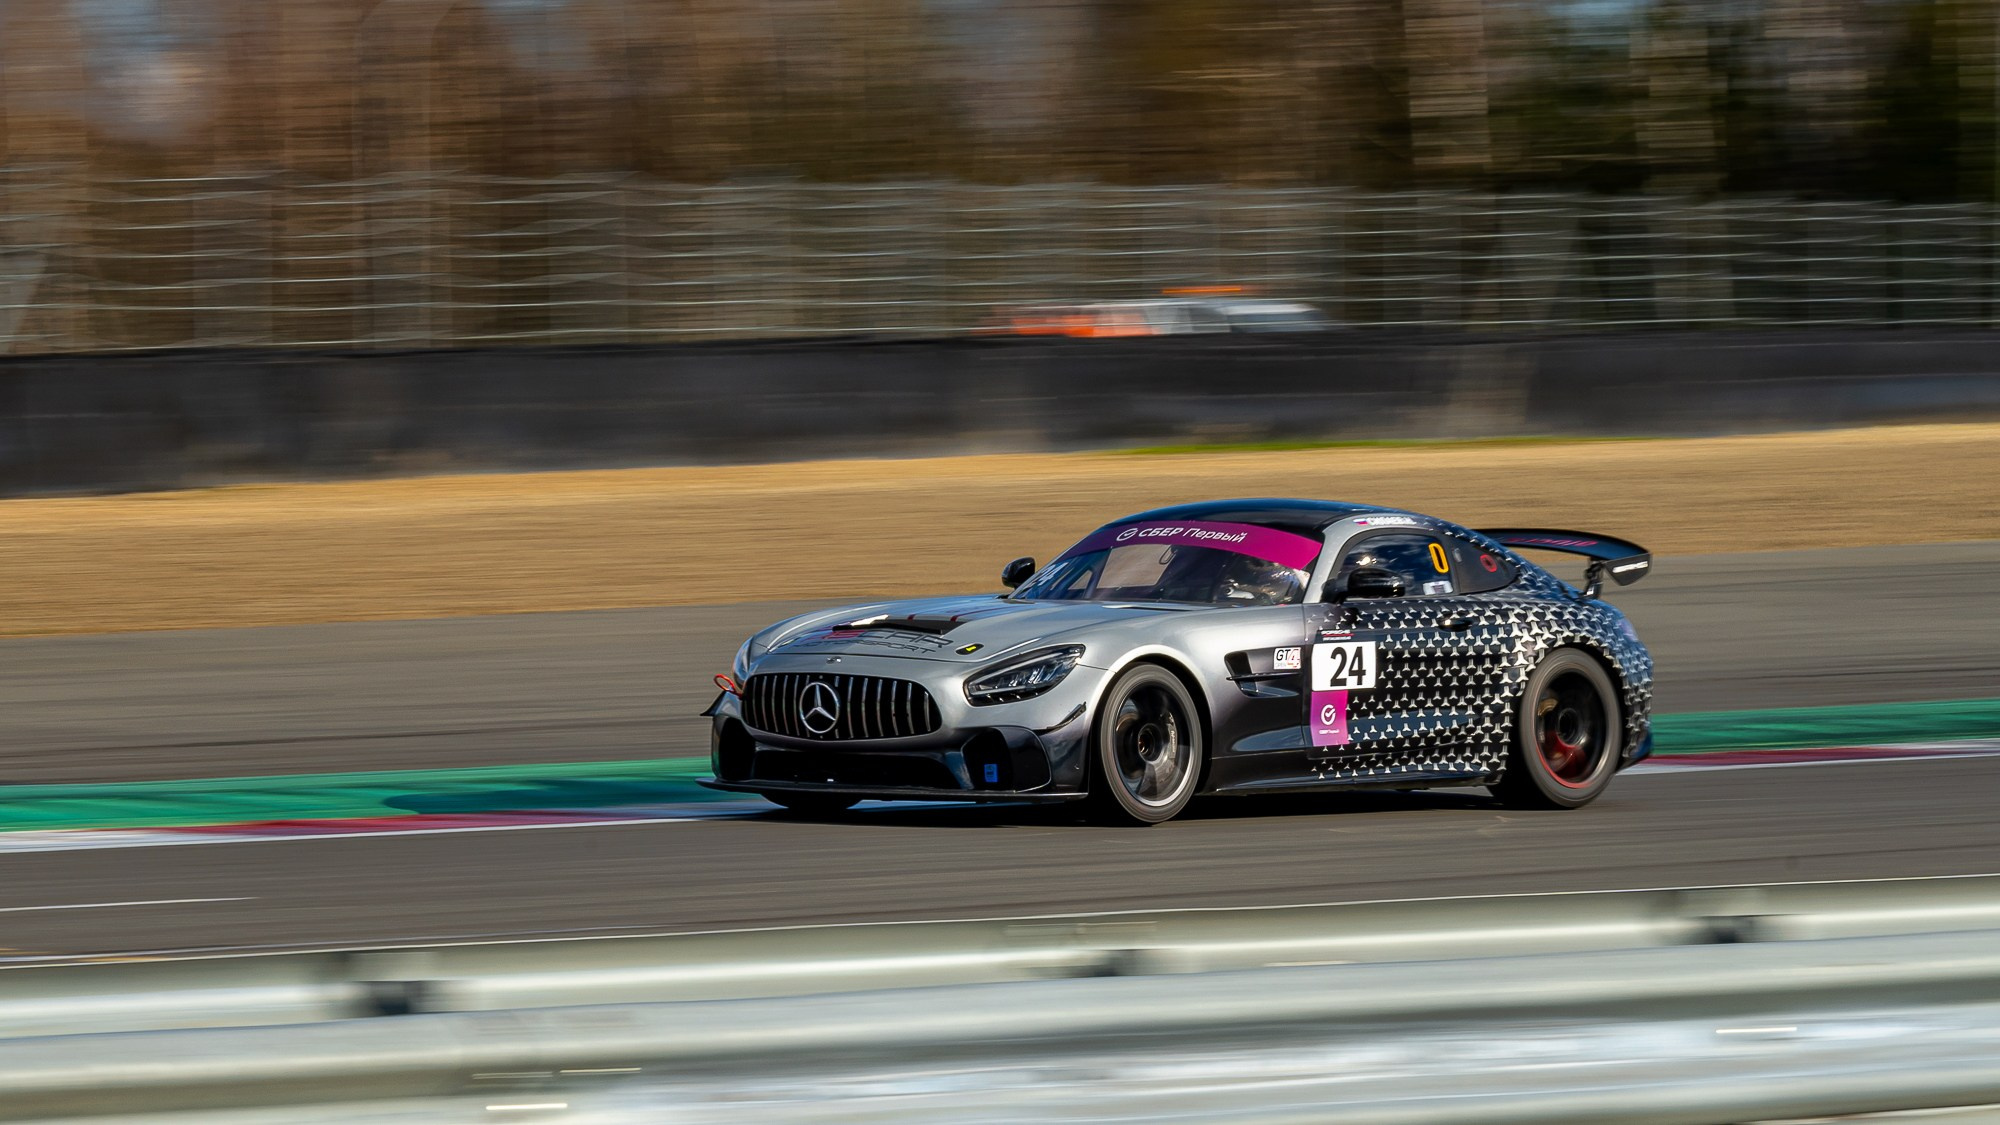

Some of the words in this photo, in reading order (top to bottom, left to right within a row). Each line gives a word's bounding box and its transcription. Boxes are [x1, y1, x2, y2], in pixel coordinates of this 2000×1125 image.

[1138, 527, 1184, 537] СБЕР
[1183, 528, 1248, 543] Первый
[1330, 646, 1366, 687] 24
